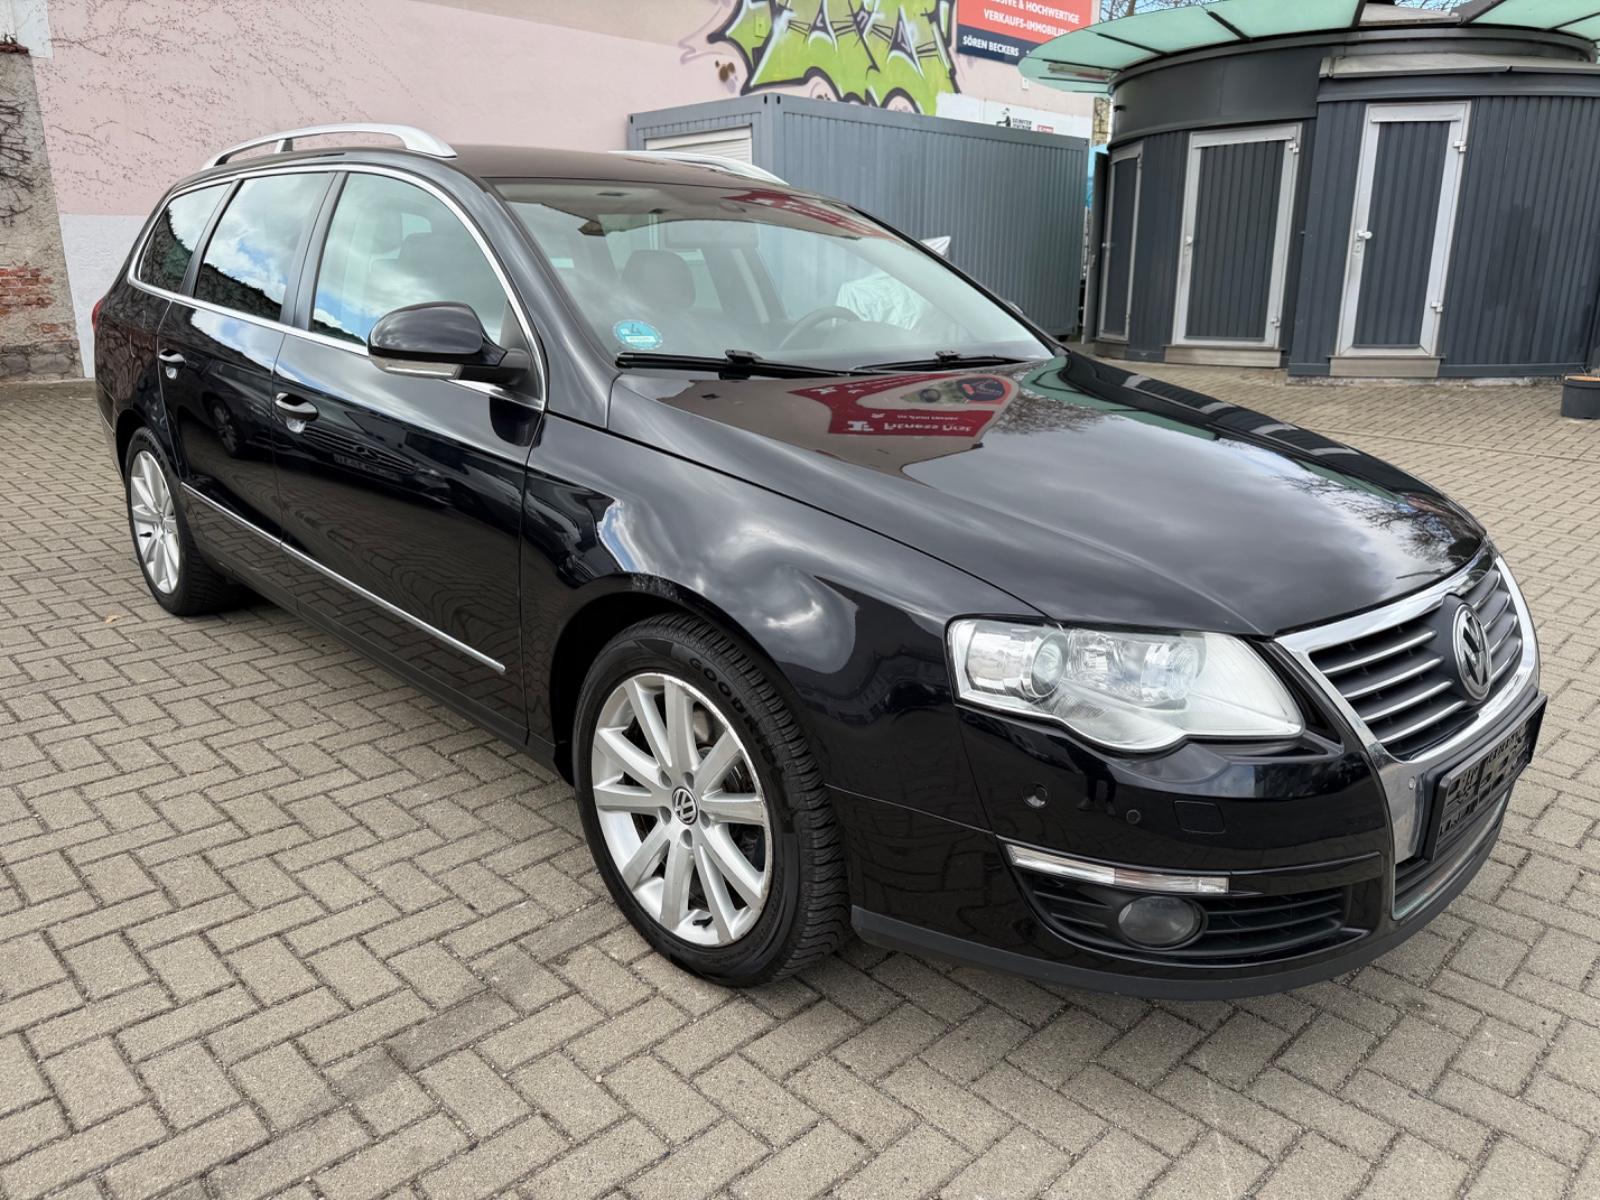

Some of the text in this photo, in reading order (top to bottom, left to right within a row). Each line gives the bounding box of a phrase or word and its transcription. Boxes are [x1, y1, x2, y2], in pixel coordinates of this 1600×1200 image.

[984, 9, 1070, 37] VERKAUFS-IMMOBILIE
[1026, 1, 1080, 24] HOCHWERTIGE
[962, 35, 1019, 57] SÖREN BECKERS
